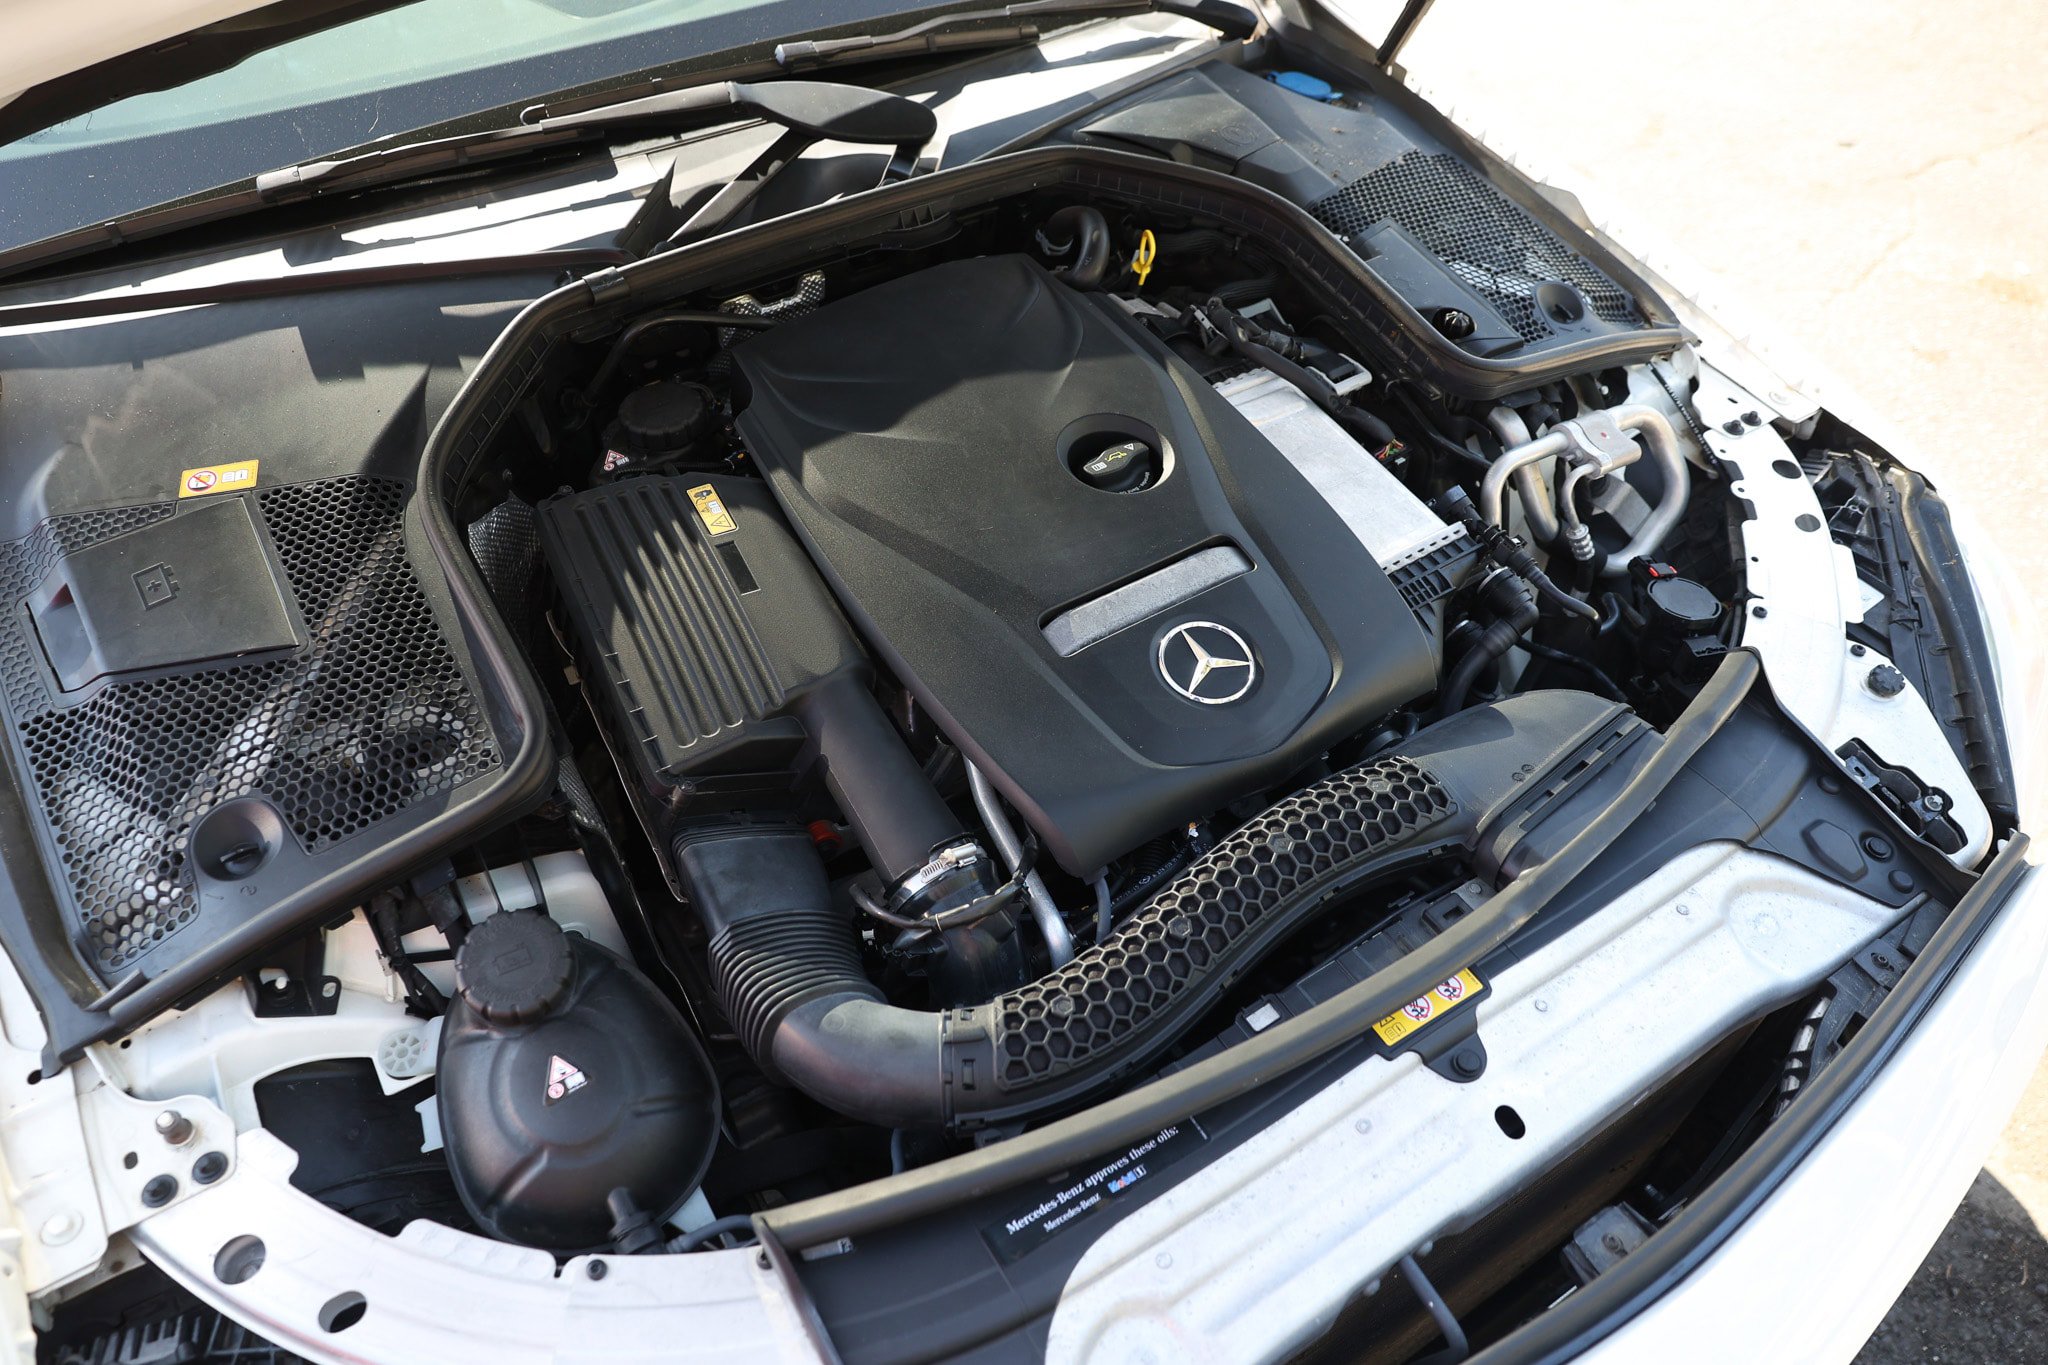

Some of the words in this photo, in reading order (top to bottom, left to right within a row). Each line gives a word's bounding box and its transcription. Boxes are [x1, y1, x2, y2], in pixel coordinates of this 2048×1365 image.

[1005, 1183, 1085, 1234] Mercedes-Benz
[1085, 1156, 1129, 1187] approves
[1129, 1139, 1157, 1160] these
[1157, 1126, 1179, 1144] oils:
[1043, 1193, 1101, 1232] Mercedes-Benz
